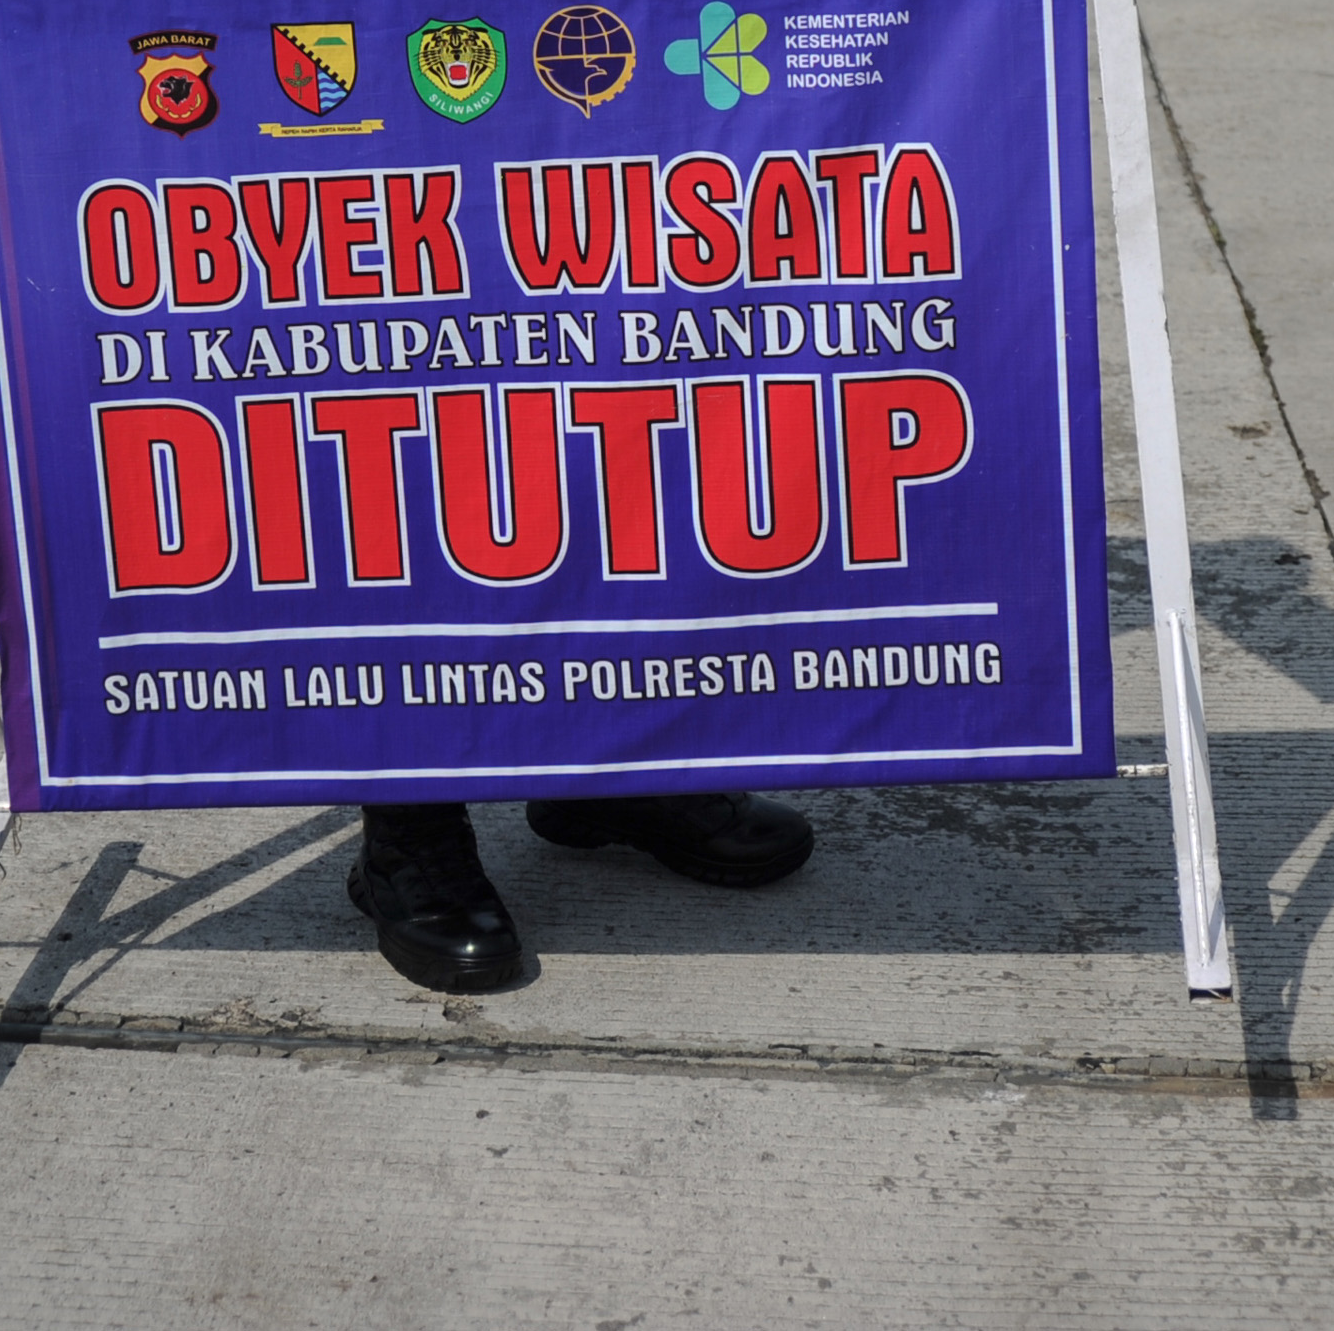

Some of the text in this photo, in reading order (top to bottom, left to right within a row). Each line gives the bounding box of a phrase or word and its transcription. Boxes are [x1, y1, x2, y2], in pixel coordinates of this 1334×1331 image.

[783, 10, 910, 30] KEMENTERIAN
[136, 34, 212, 50] JAWA BARAT
[784, 31, 889, 49] KESEHATAN
[786, 52, 874, 69] REPUBLIK
[786, 70, 884, 88] INDONESIA
[428, 91, 495, 115] SILIWANGI
[78, 142, 962, 314] OBYEK WISATA
[96, 298, 957, 387] DI KABUPATEN BANDUNG
[91, 369, 975, 599] DITUTUP
[103, 640, 1003, 716] SATUAN LALU LINTAS POLRESTA BANDUNG
